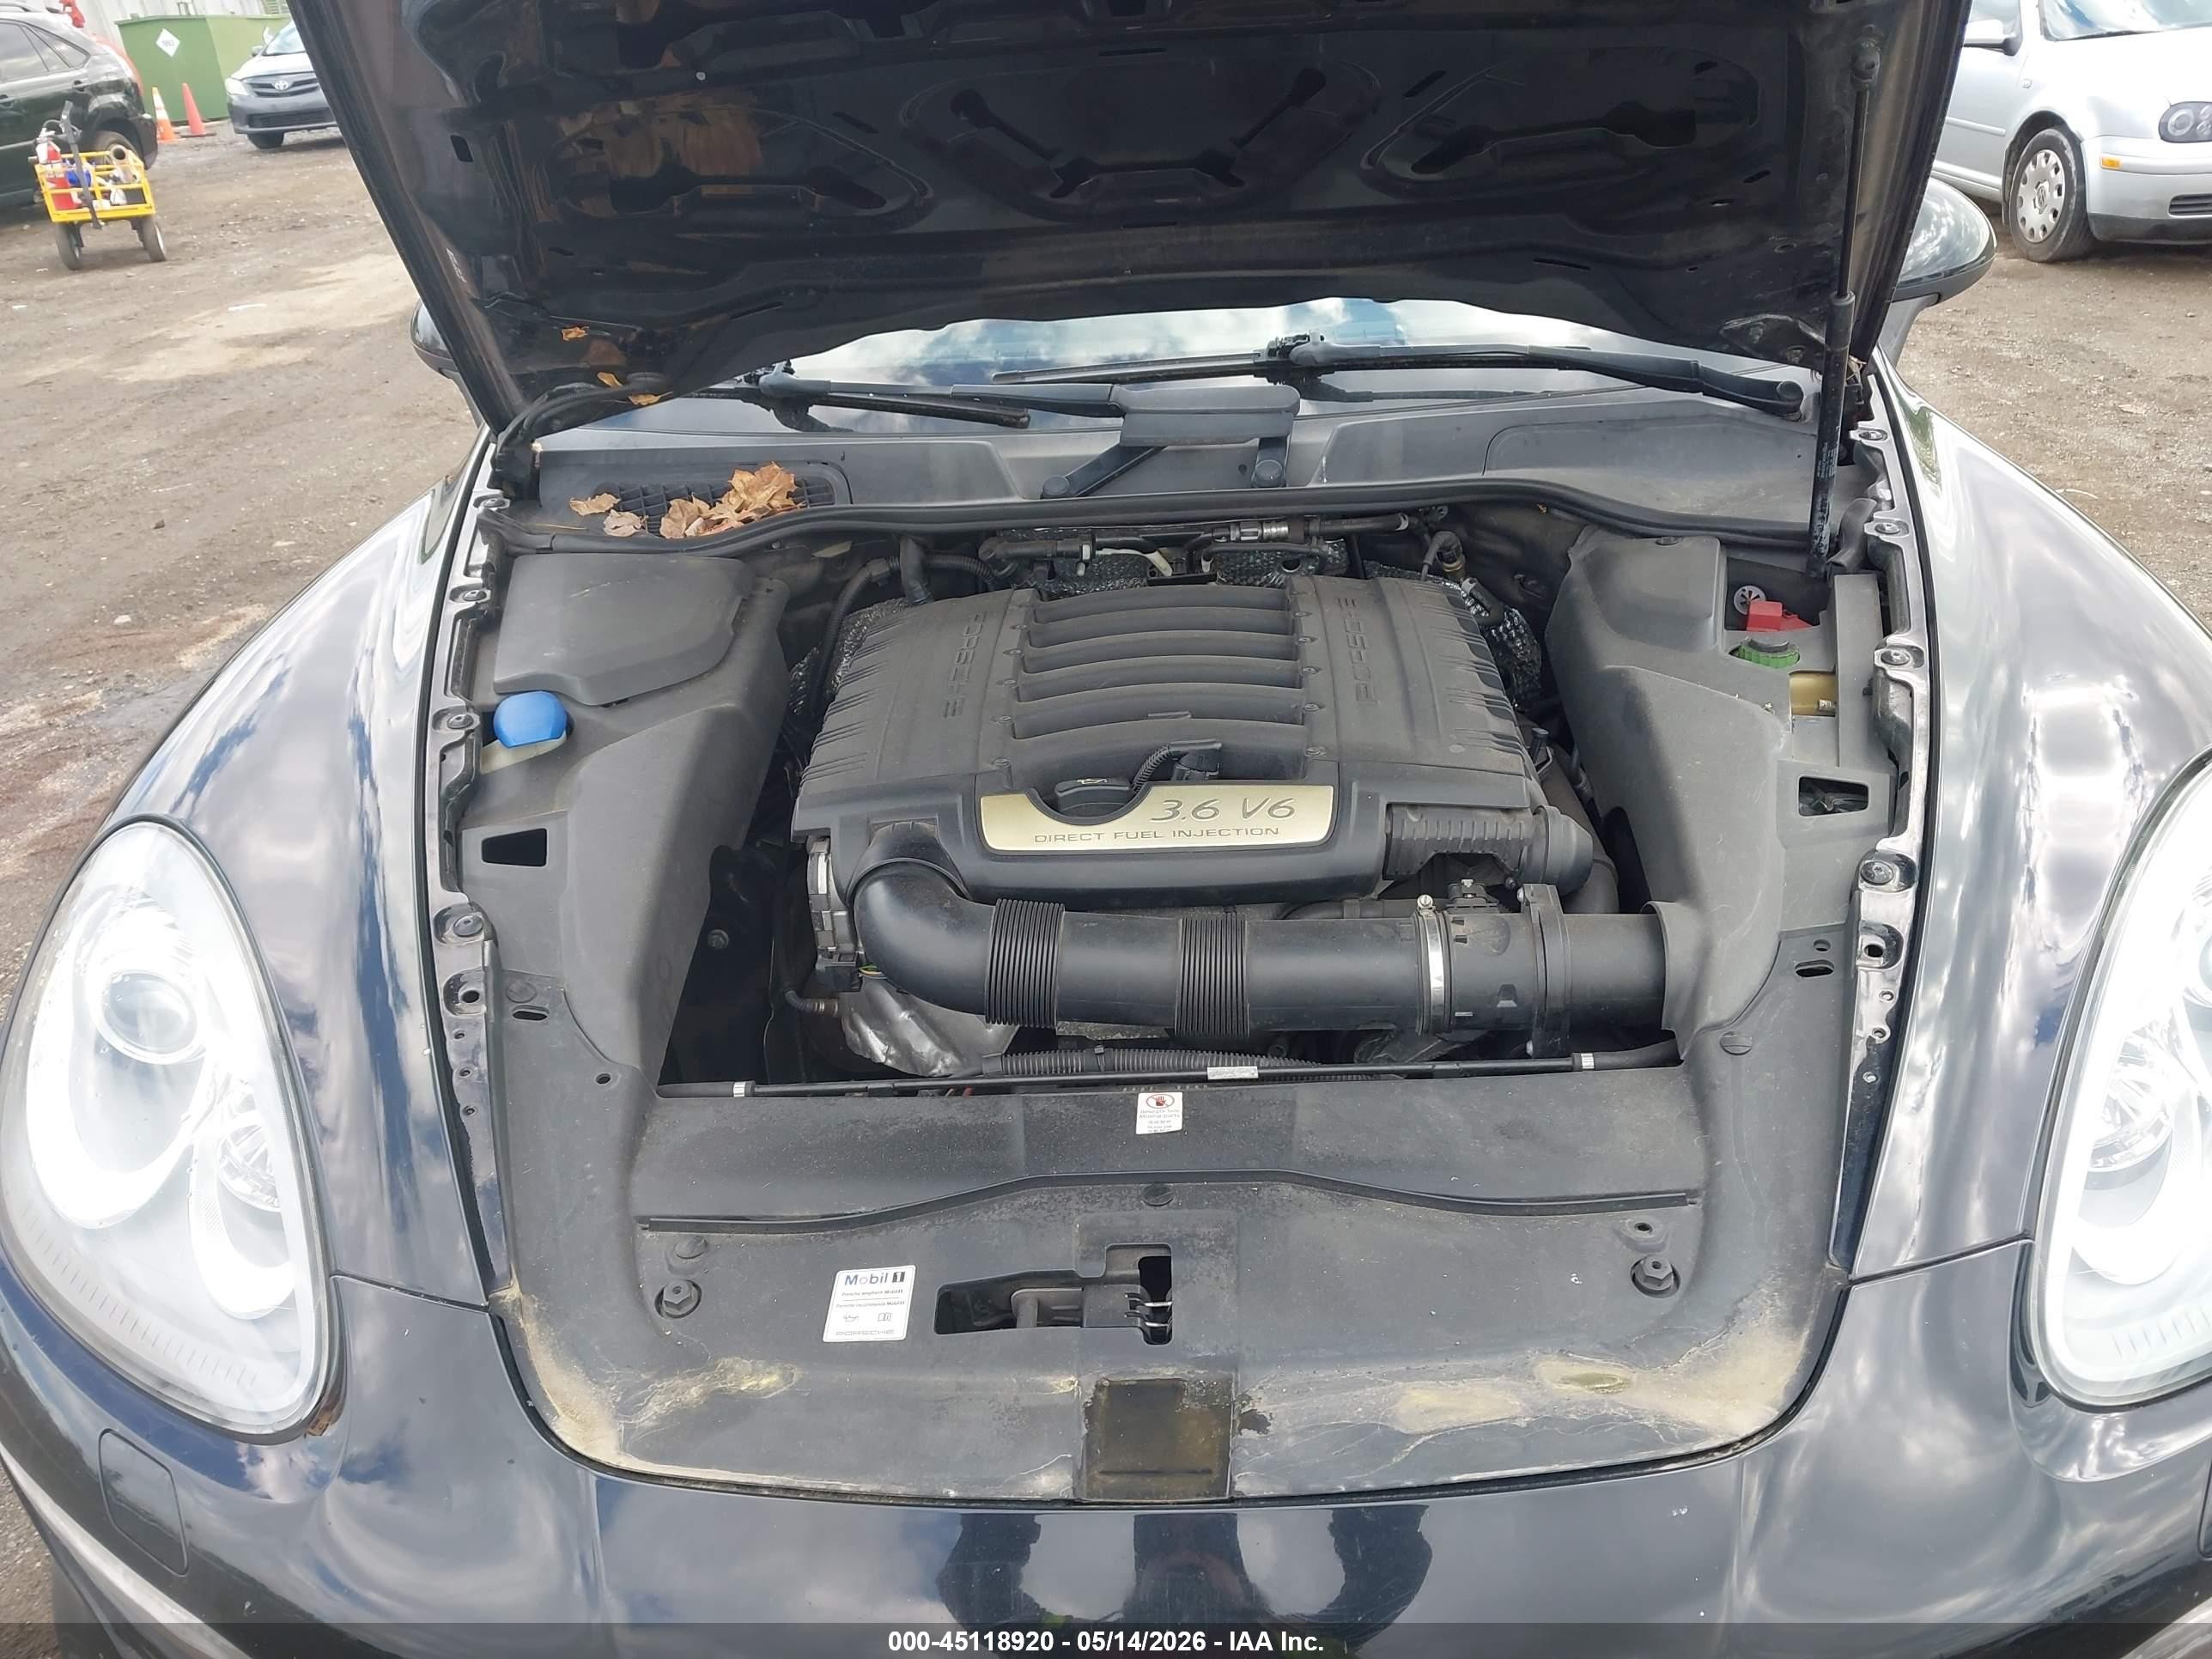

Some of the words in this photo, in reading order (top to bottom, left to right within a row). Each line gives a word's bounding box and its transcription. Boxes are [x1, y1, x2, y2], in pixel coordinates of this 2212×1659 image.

[1150, 799, 1220, 821] 3.6
[1242, 798, 1296, 819] V6
[1034, 832, 1105, 842] DIRECT
[1114, 830, 1164, 840] FUEL
[1172, 828, 1279, 838] INJECTION
[844, 1273, 889, 1285] Mobil
